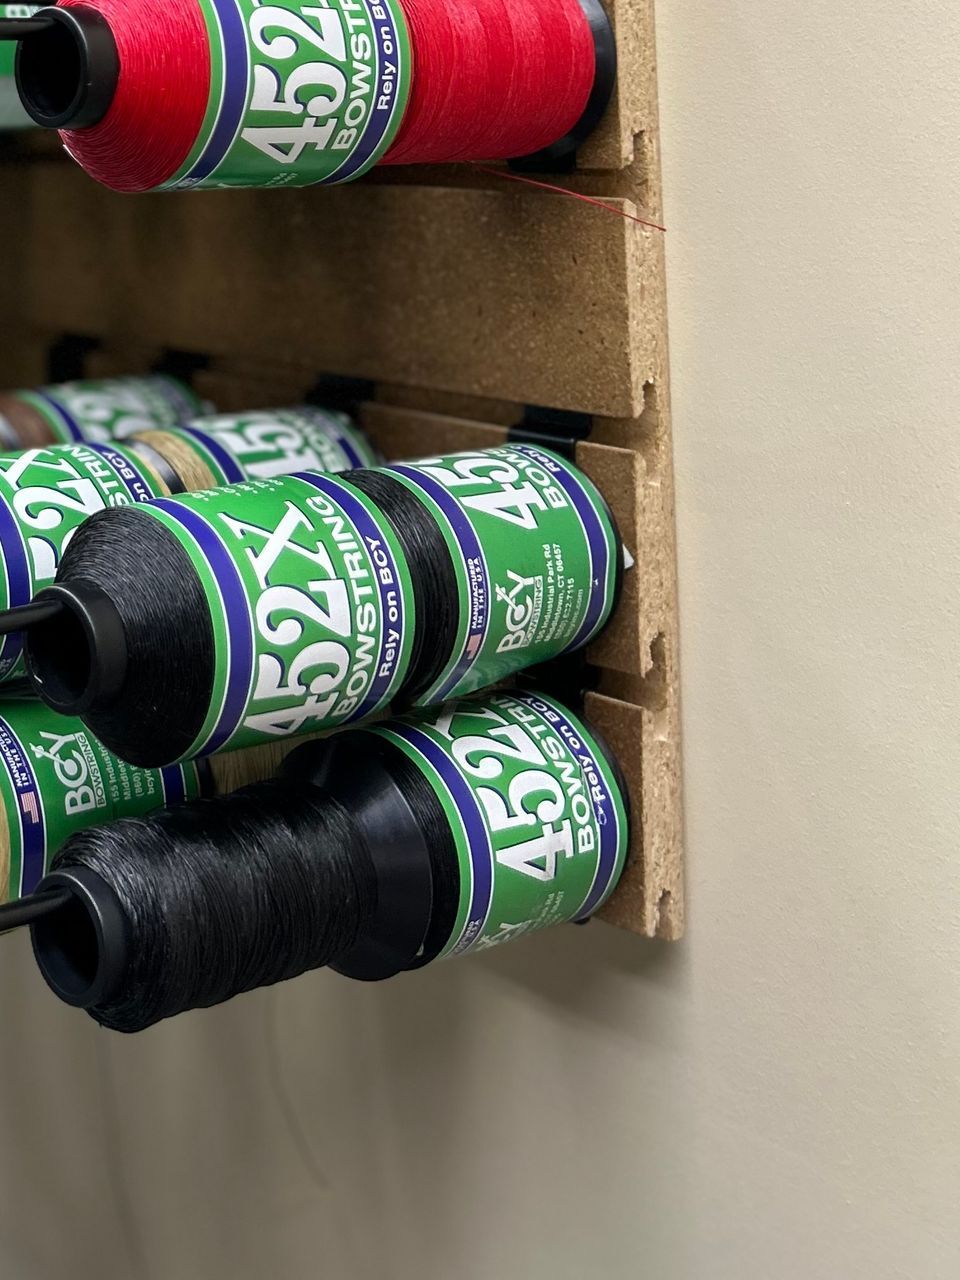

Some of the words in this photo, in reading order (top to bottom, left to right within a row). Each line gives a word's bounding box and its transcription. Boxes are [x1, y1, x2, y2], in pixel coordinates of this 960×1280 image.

[380, 26, 394, 54] on
[376, 60, 396, 110] Rely
[102, 451, 136, 480] BCY
[365, 536, 395, 585] BCY
[542, 544, 552, 558] Rd
[552, 543, 564, 572] 06457
[473, 557, 483, 582] USA
[546, 560, 555, 583] Park
[557, 574, 565, 588] CT
[217, 499, 352, 736] 452X
[305, 495, 377, 717] BOWSTRING
[386, 591, 399, 621] on
[495, 569, 535, 654] BCY
[476, 615, 484, 628] IN
[379, 629, 400, 677] Rely
[521, 696, 561, 723] BCY
[560, 725, 580, 750] on
[10, 748, 22, 768] THE
[77, 734, 106, 807] BOWSTRING
[20, 772, 30, 786] IN
[31, 730, 96, 816] BCY
[578, 753, 607, 802] Rely
[423, 703, 575, 882] 452X
